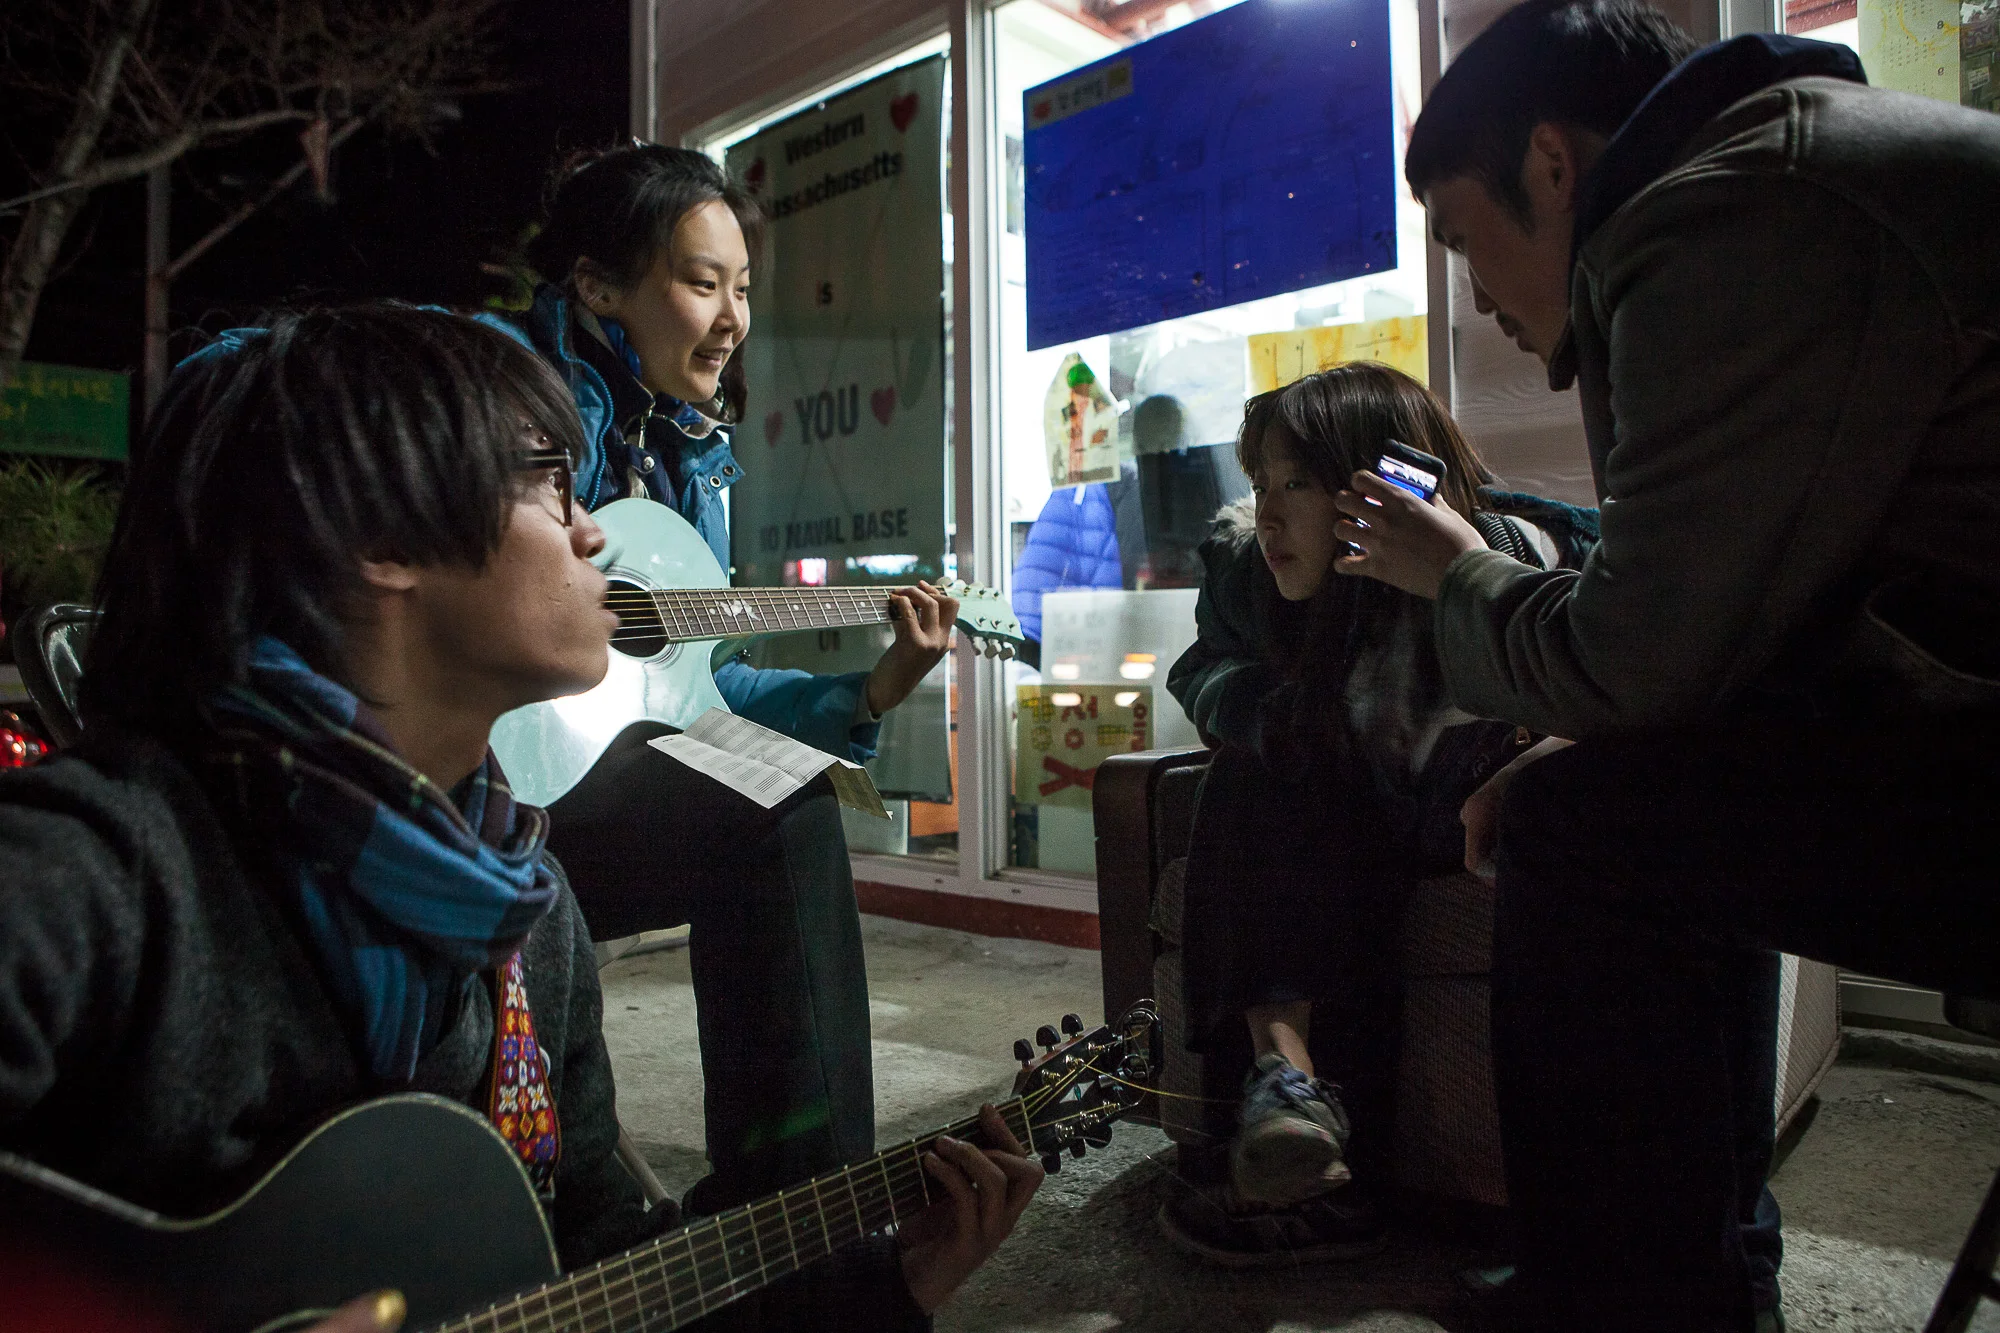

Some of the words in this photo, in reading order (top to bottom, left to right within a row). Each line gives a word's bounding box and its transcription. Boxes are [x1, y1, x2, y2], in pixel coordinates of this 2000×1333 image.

[785, 113, 864, 165] Western
[768, 151, 903, 218] assachusetts
[794, 383, 858, 444] YOU
[785, 515, 846, 549] NAVAL
[852, 507, 909, 541] BASE
